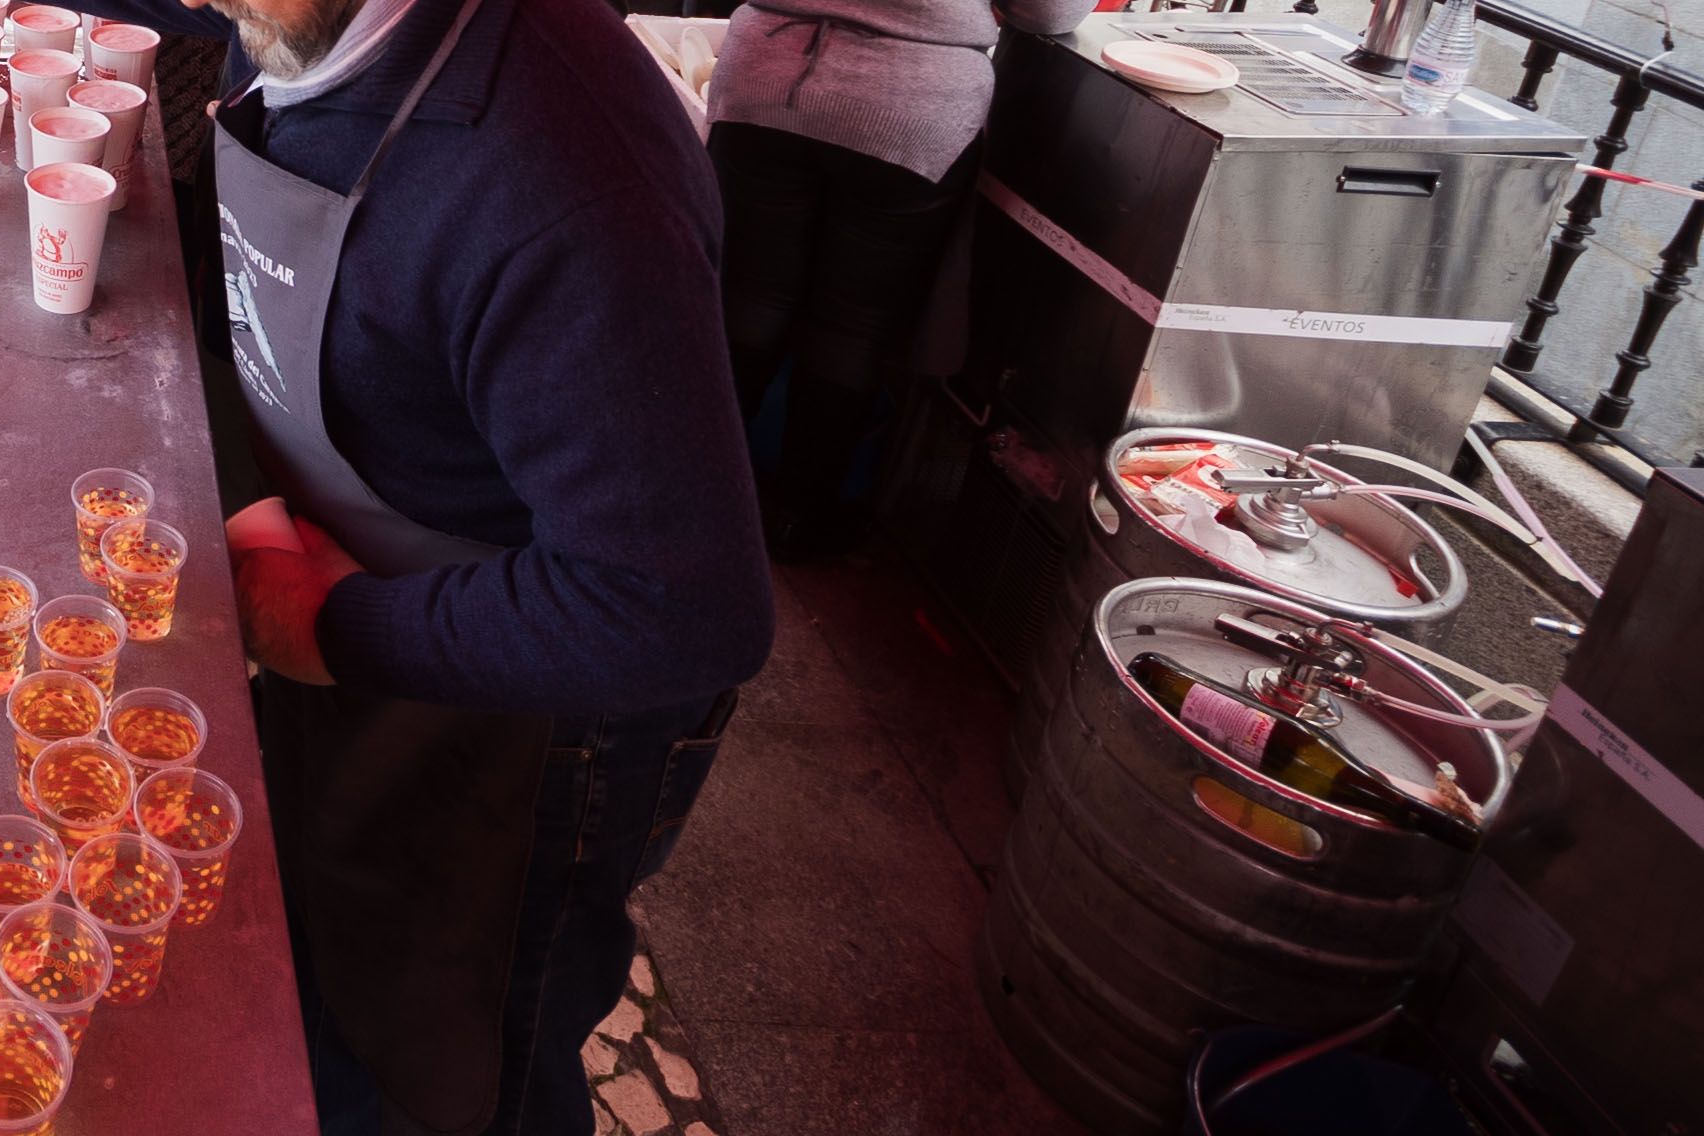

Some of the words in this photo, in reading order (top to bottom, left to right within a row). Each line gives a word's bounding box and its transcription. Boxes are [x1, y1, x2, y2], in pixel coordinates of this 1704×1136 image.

[1019, 207, 1065, 247] EVENTOS
[38, 263, 84, 280] zcampo
[243, 237, 295, 287] POPULAR
[1288, 316, 1366, 334] EVENTOS
